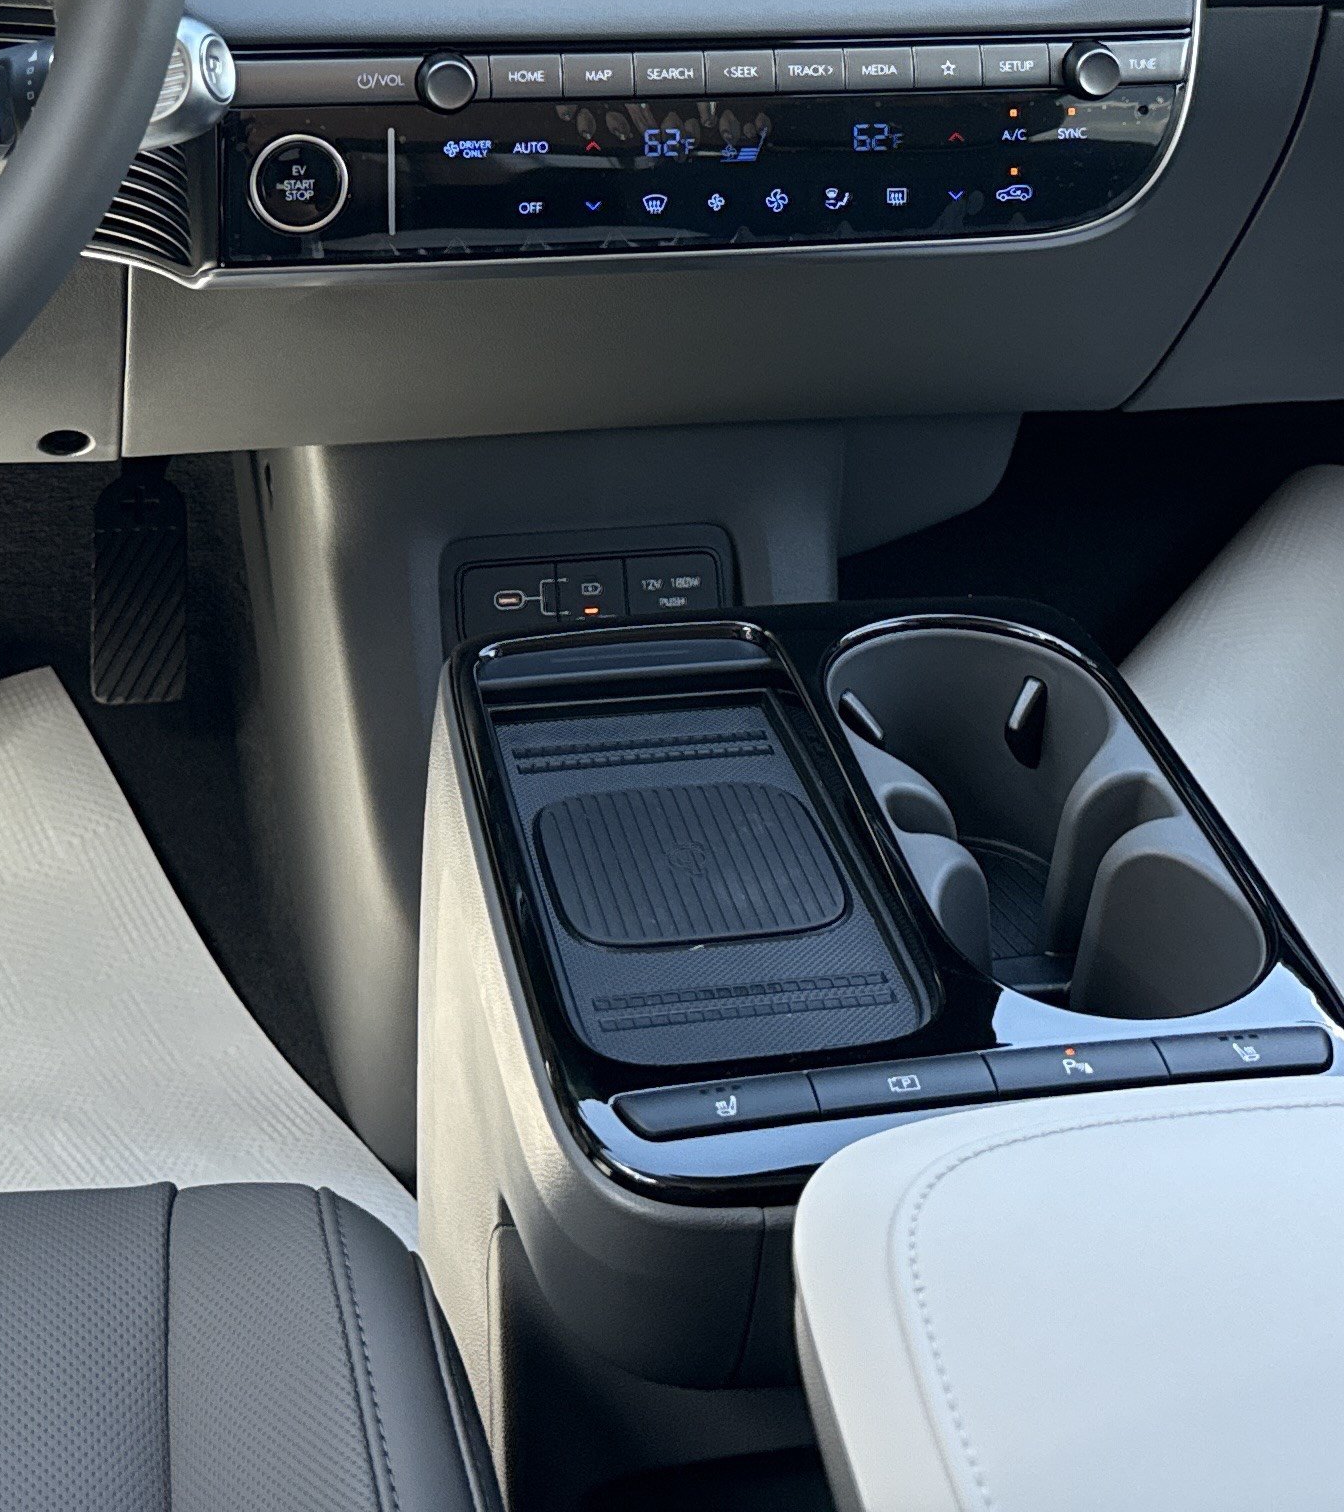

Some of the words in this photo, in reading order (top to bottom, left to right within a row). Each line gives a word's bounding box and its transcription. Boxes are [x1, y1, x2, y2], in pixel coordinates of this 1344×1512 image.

[862, 64, 897, 76] MEDIA
[999, 59, 1033, 72] SETUP
[1129, 58, 1156, 70] TUNE
[508, 70, 544, 82] HOME
[586, 69, 611, 81] MAP
[647, 67, 694, 80] SEARCH
[731, 65, 758, 78] SEEK
[788, 64, 826, 77] TRACK
[1002, 129, 1027, 141] A/C
[1058, 127, 1087, 140] SYNC
[459, 141, 491, 152] DRIVER
[513, 141, 548, 154] AUTO
[463, 148, 488, 159] ONLY
[292, 165, 306, 176] EV
[284, 179, 315, 190] START
[285, 191, 314, 201] STOP
[519, 202, 542, 214] OFF
